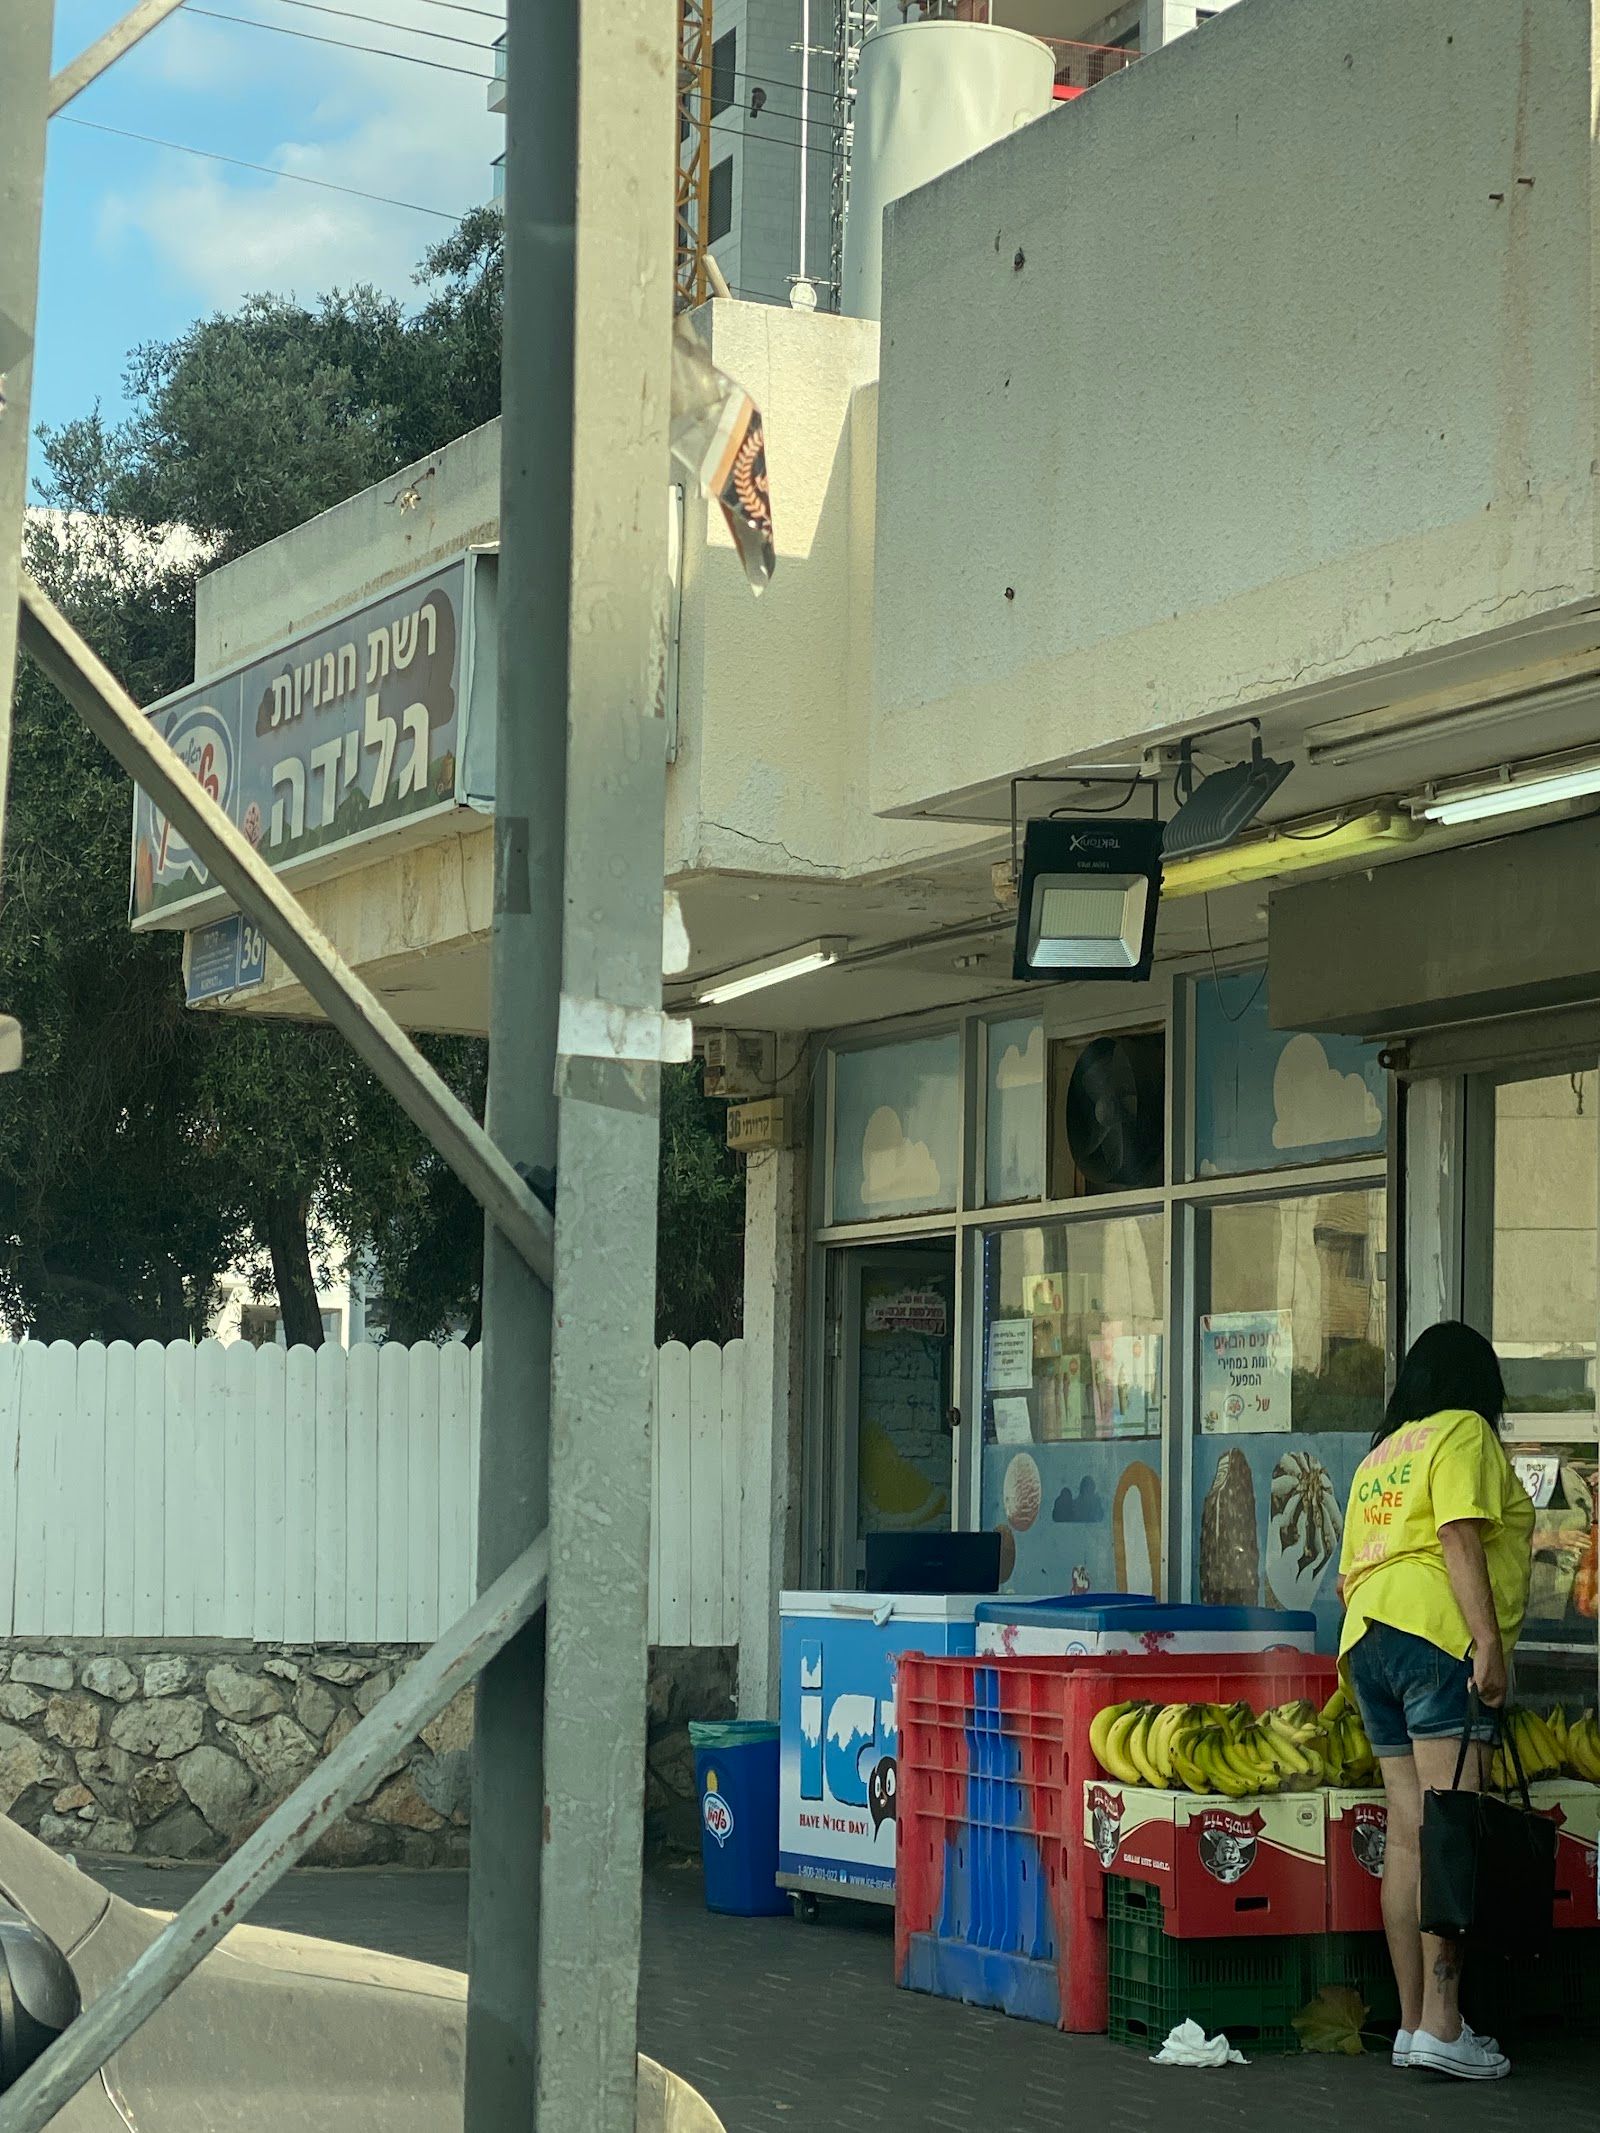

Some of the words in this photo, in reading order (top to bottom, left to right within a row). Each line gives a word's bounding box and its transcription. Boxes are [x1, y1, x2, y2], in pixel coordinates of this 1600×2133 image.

[366, 603, 437, 684] רשת
[271, 641, 357, 728] חנויות
[269, 694, 431, 849] גלידה
[241, 927, 262, 969] 36
[728, 1110, 741, 1139] 36
[1230, 1371, 1262, 1387] המפעל
[1255, 1394, 1271, 1412] של
[800, 1813, 819, 1829] HAVE
[848, 1820, 869, 1837] DAY!
